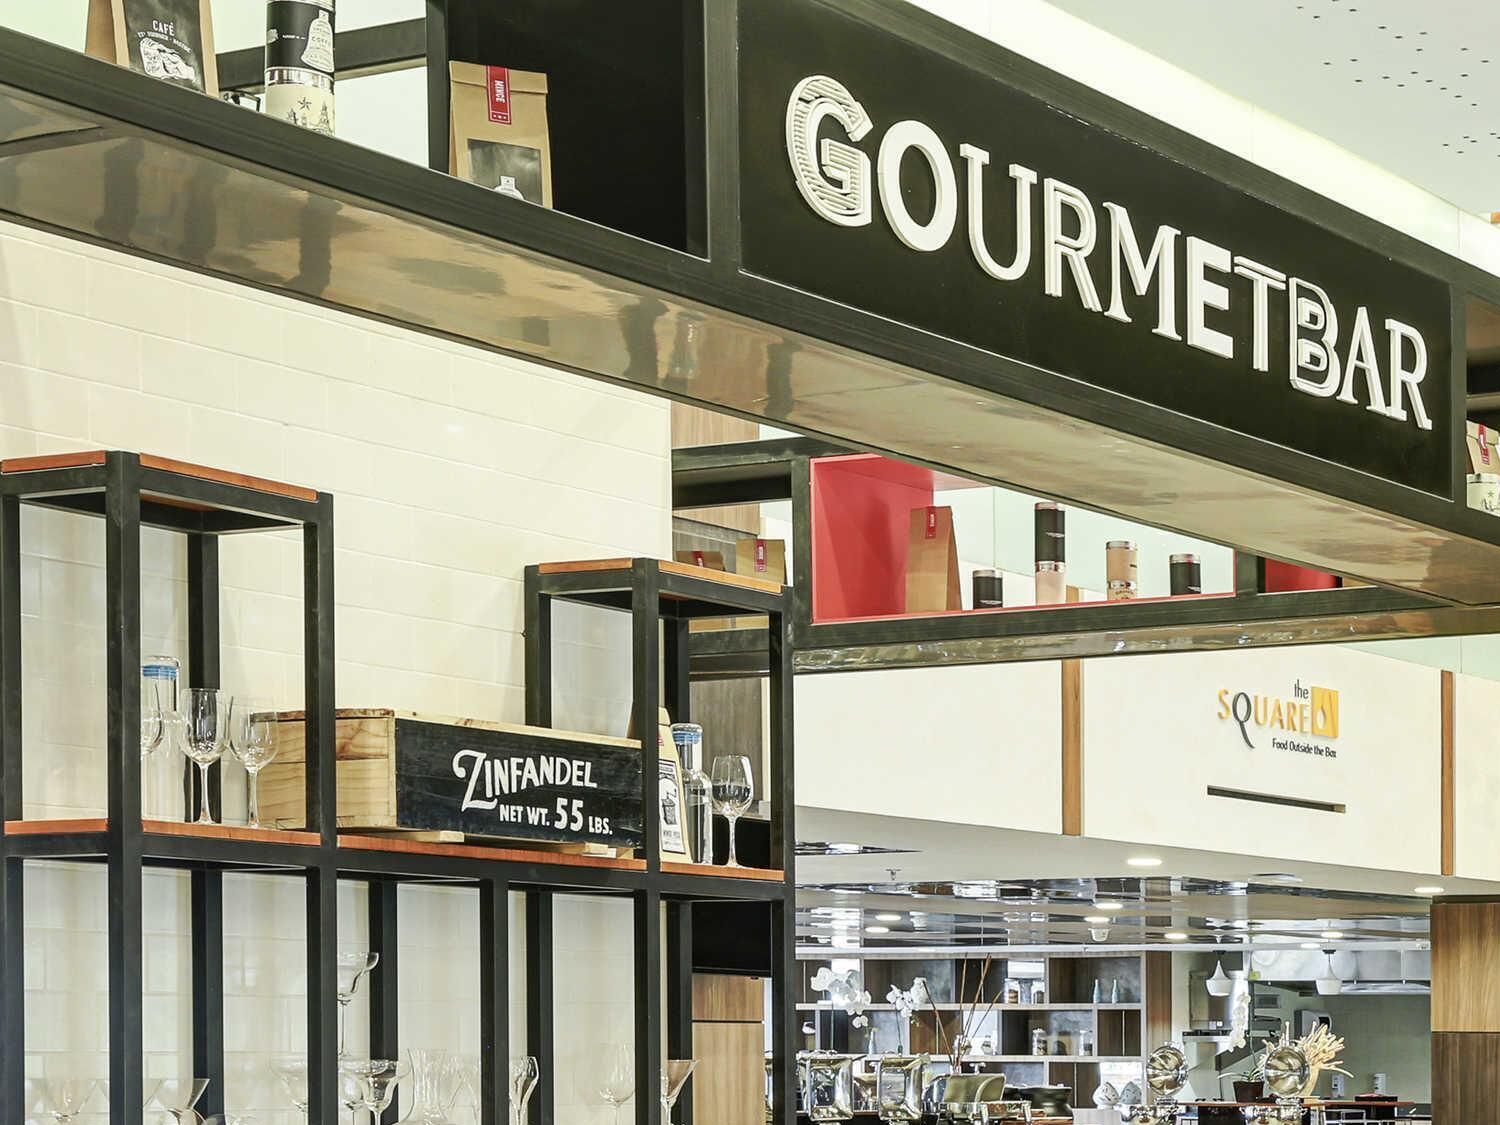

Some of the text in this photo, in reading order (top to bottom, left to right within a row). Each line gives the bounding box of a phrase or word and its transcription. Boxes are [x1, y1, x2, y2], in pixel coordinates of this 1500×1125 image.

[152, 20, 175, 37] CAFÉ
[785, 74, 1433, 430] GOURMETBAR
[1294, 679, 1309, 699] the
[1217, 688, 1310, 749] SQUARE
[1272, 737, 1337, 758] Food Outside the Box
[452, 749, 598, 812] ZINFANDEL
[500, 797, 613, 835] NET WT. 55 LBS.
